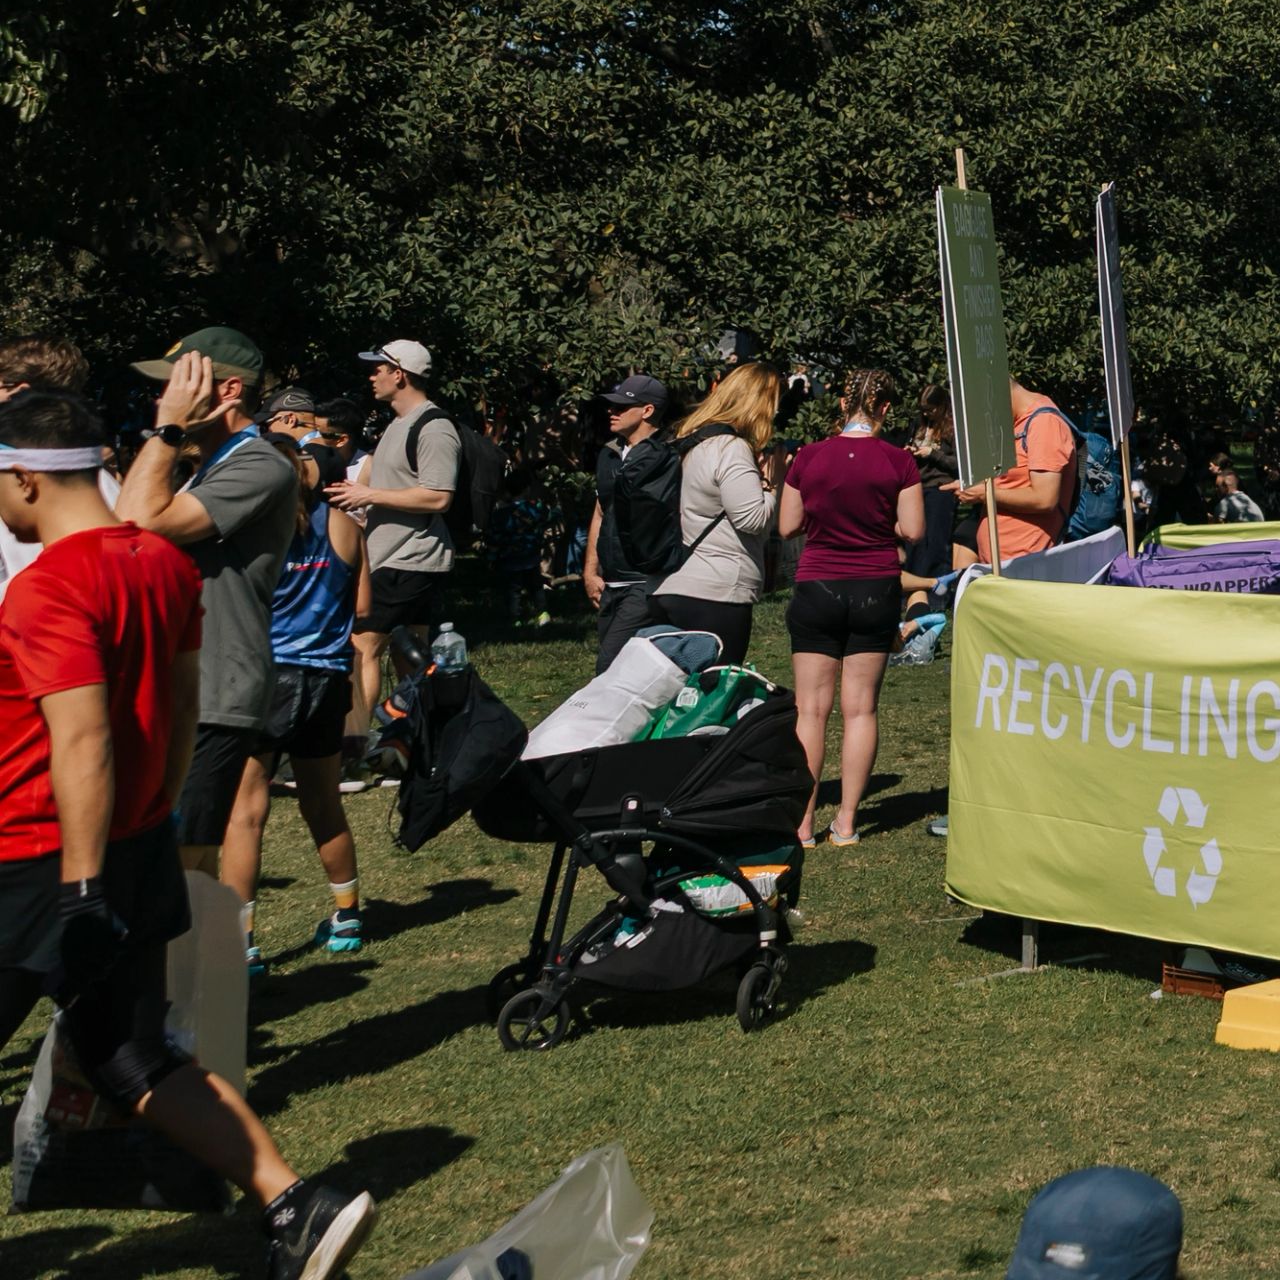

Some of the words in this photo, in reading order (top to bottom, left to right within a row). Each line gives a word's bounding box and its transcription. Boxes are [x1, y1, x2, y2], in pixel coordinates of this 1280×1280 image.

[953, 202, 988, 239] BAGGAGE
[968, 243, 986, 278] AND
[975, 323, 995, 359] BAGS
